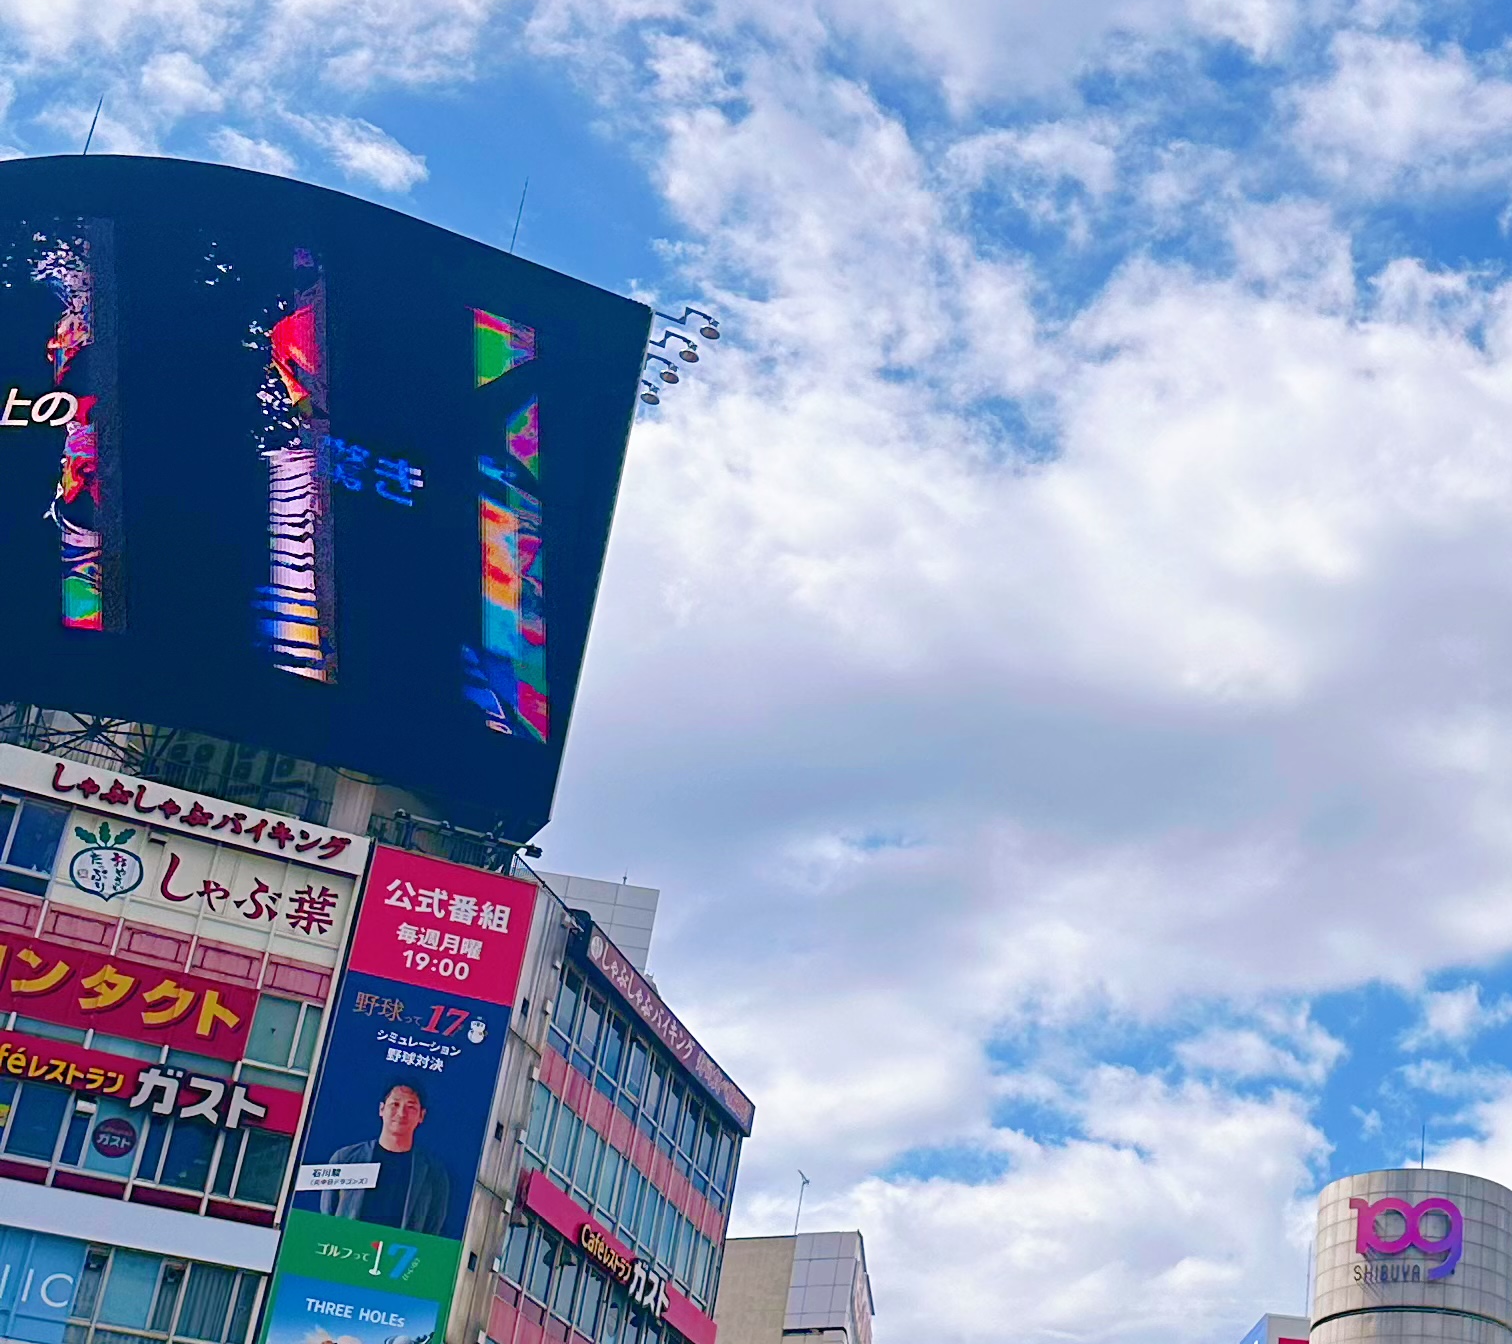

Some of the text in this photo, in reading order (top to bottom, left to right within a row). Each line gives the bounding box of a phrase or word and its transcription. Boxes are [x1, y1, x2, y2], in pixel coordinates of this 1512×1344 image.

[52, 762, 351, 860] しゃぶしゃぶバイキング
[160, 852, 339, 936] しゃぶ葉
[384, 879, 513, 934] 公式番組
[396, 922, 483, 960] 毎週月曜
[402, 949, 470, 980] 19:00
[0, 945, 241, 1036] ンタクト
[376, 1029, 462, 1057] シミュレーション
[386, 1048, 444, 1073] 野球対決
[130, 1067, 267, 1128] ガスト
[96, 1133, 131, 1149] ガスト
[1349, 1197, 1463, 1281] 109
[629, 1259, 670, 1318] ガスト
[1353, 1264, 1421, 1283] SHIBUYA
[306, 1298, 406, 1329] THREE HOLEs
